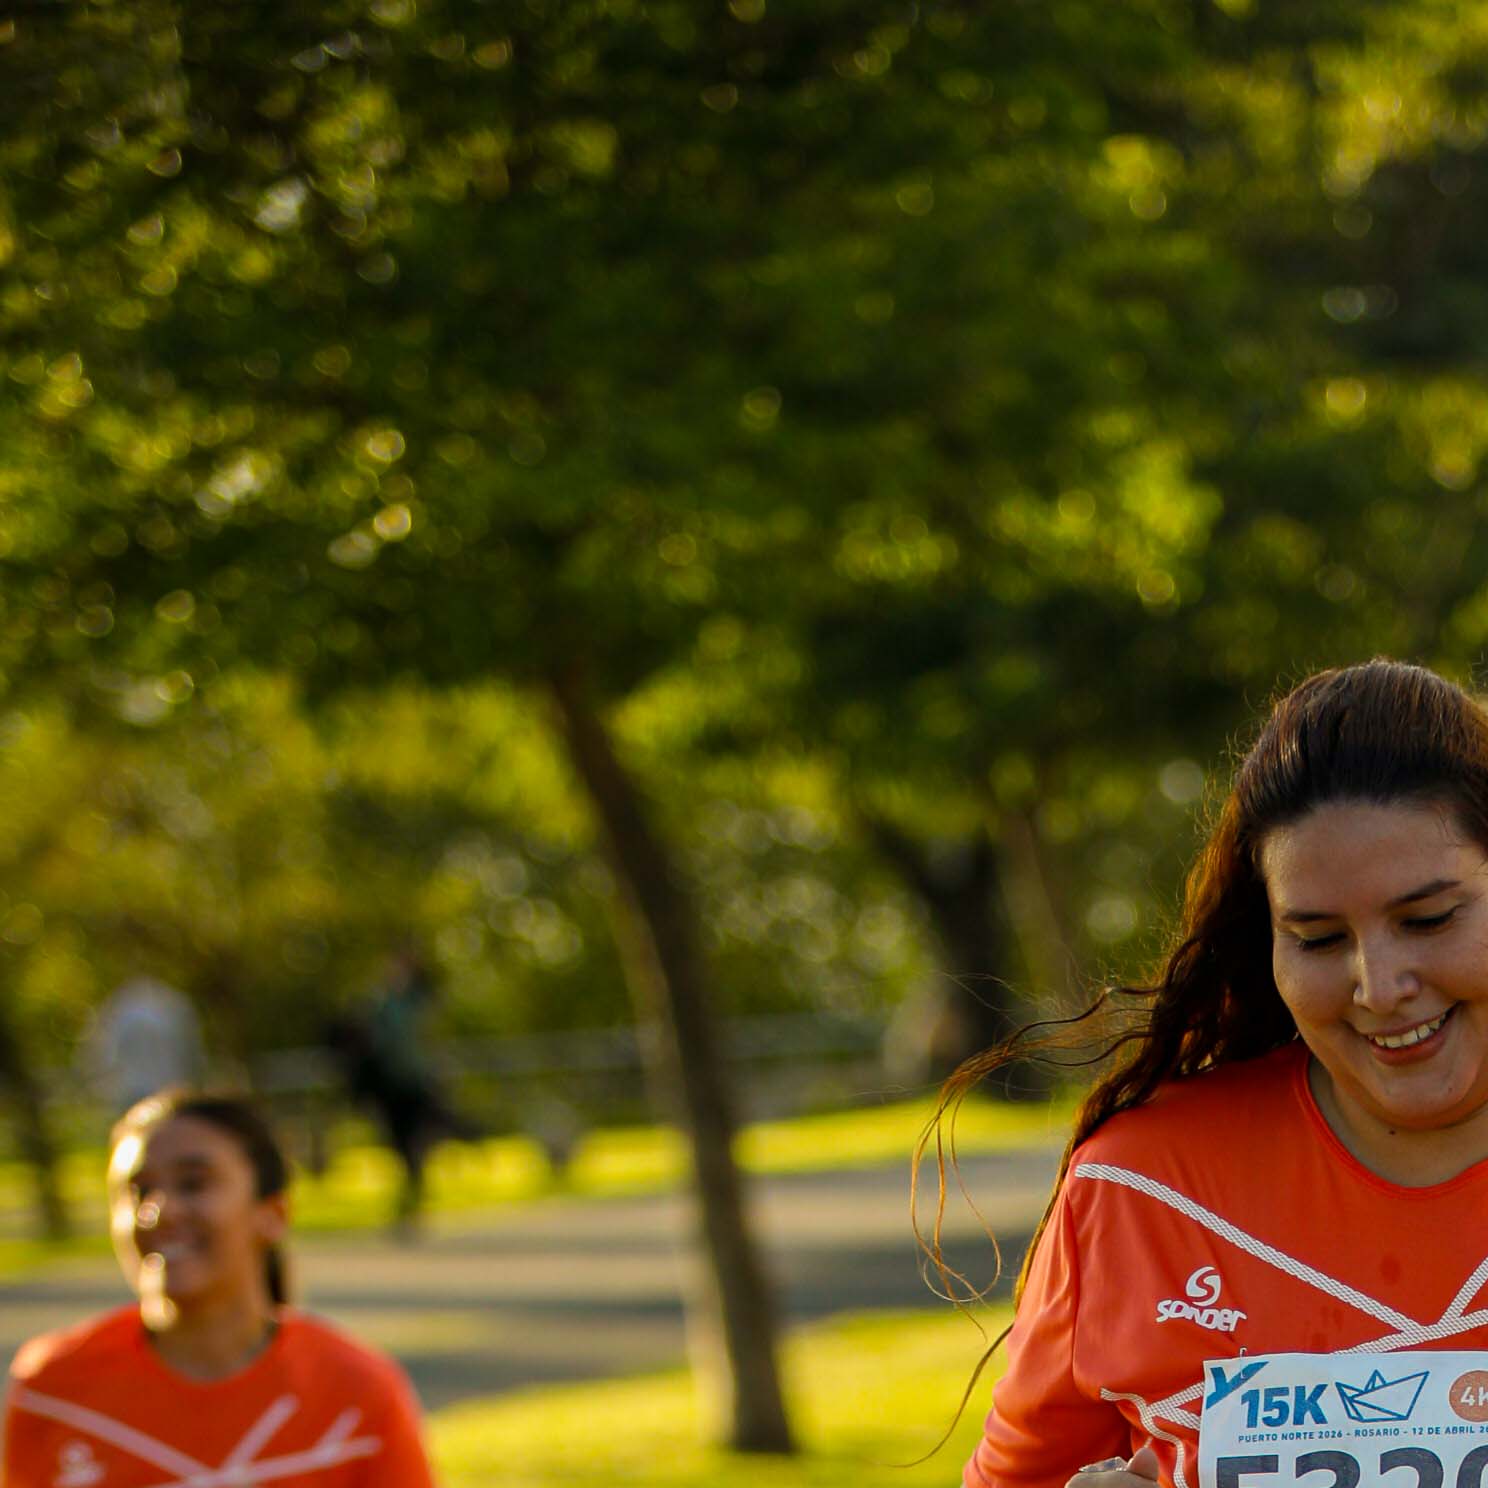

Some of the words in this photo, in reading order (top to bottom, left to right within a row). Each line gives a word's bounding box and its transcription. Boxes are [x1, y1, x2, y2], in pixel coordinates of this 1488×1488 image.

[1240, 1384, 1328, 1429] 15K
[1238, 1433, 1278, 1444] PUERTO
[1281, 1431, 1314, 1441] NORTE
[1318, 1430, 1343, 1440] 2026
[1354, 1428, 1400, 1437] ROSARIO
[1412, 1426, 1424, 1436] 12
[1427, 1426, 1441, 1435] DE
[1444, 1425, 1475, 1435] ABRIL
